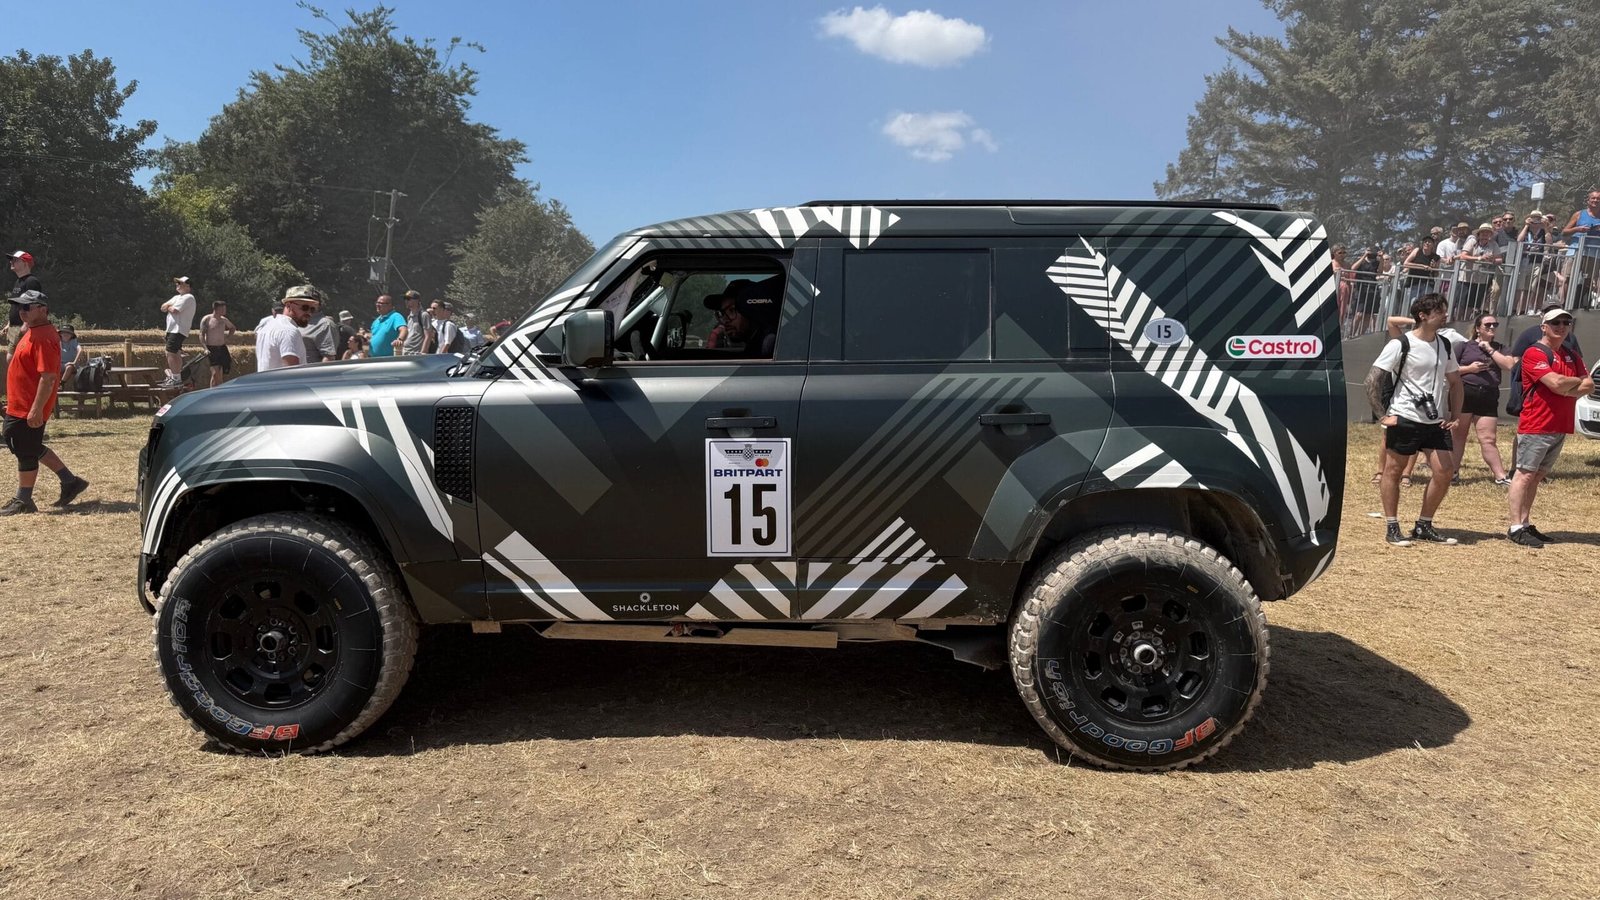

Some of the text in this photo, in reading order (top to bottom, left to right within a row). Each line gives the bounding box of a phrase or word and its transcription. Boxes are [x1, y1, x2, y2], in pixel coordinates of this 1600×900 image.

[1157, 324, 1172, 339] 15
[1248, 338, 1317, 355] Castrol
[714, 469, 783, 478] BRITPART
[724, 483, 777, 547] 15
[612, 604, 680, 613] SHACKLETON
